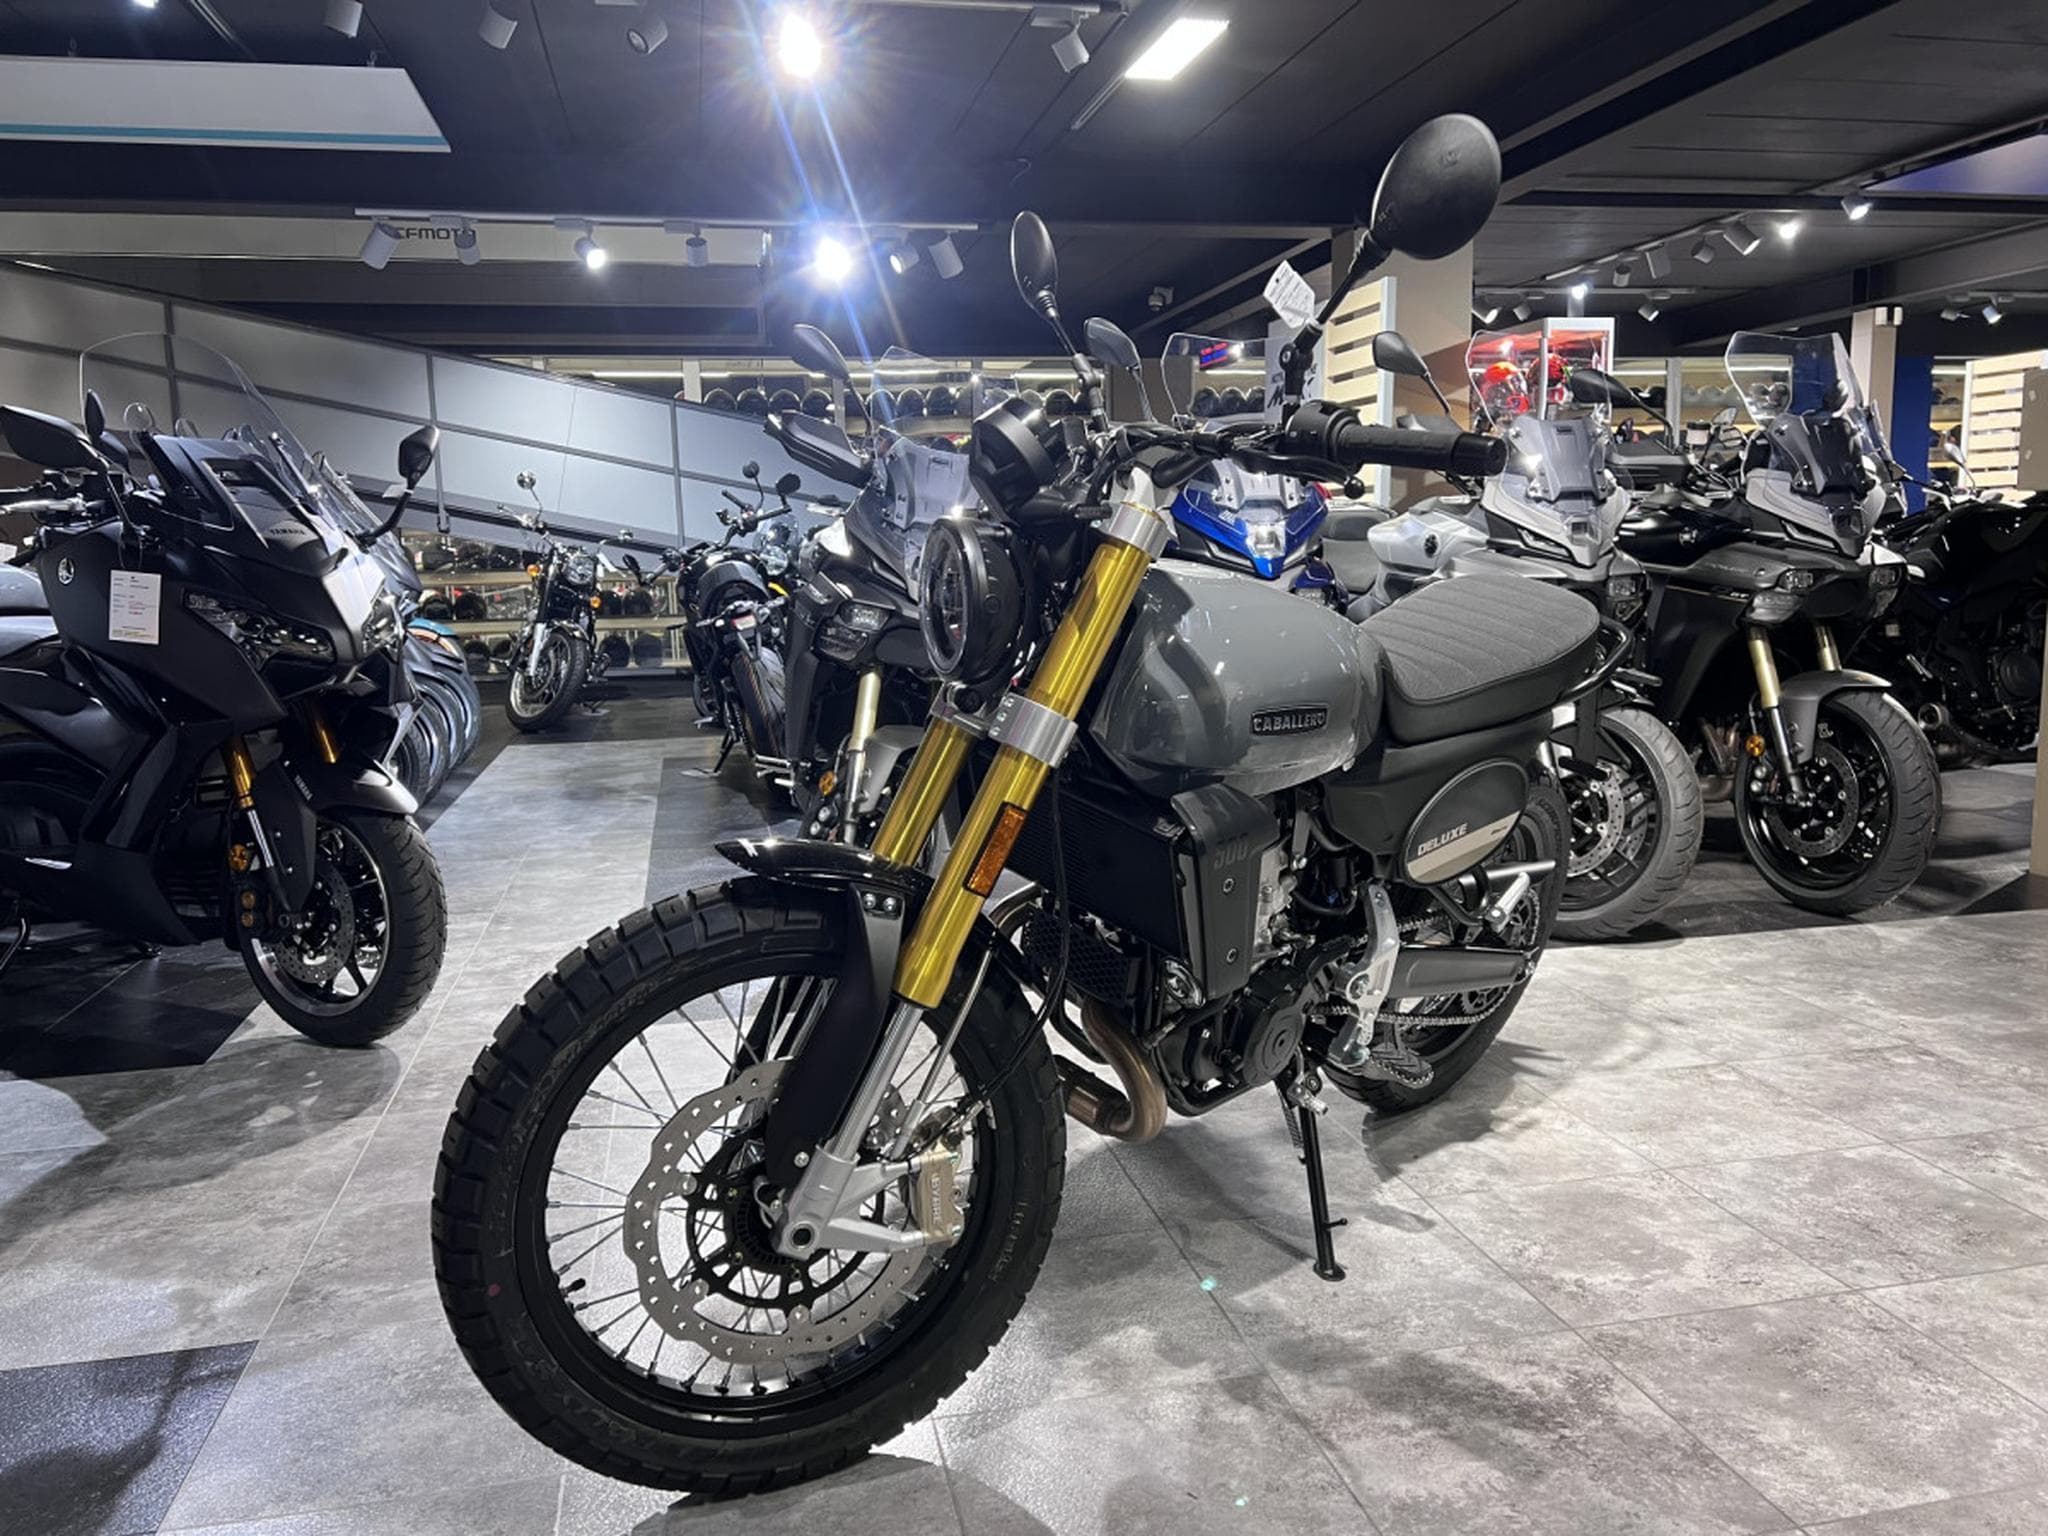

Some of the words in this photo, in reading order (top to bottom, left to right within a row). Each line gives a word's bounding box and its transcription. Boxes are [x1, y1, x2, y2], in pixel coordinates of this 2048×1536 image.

[269, 528, 306, 536] YAMAHA
[1253, 712, 1326, 732] CABALLERO
[1417, 822, 1469, 856] DELUXE
